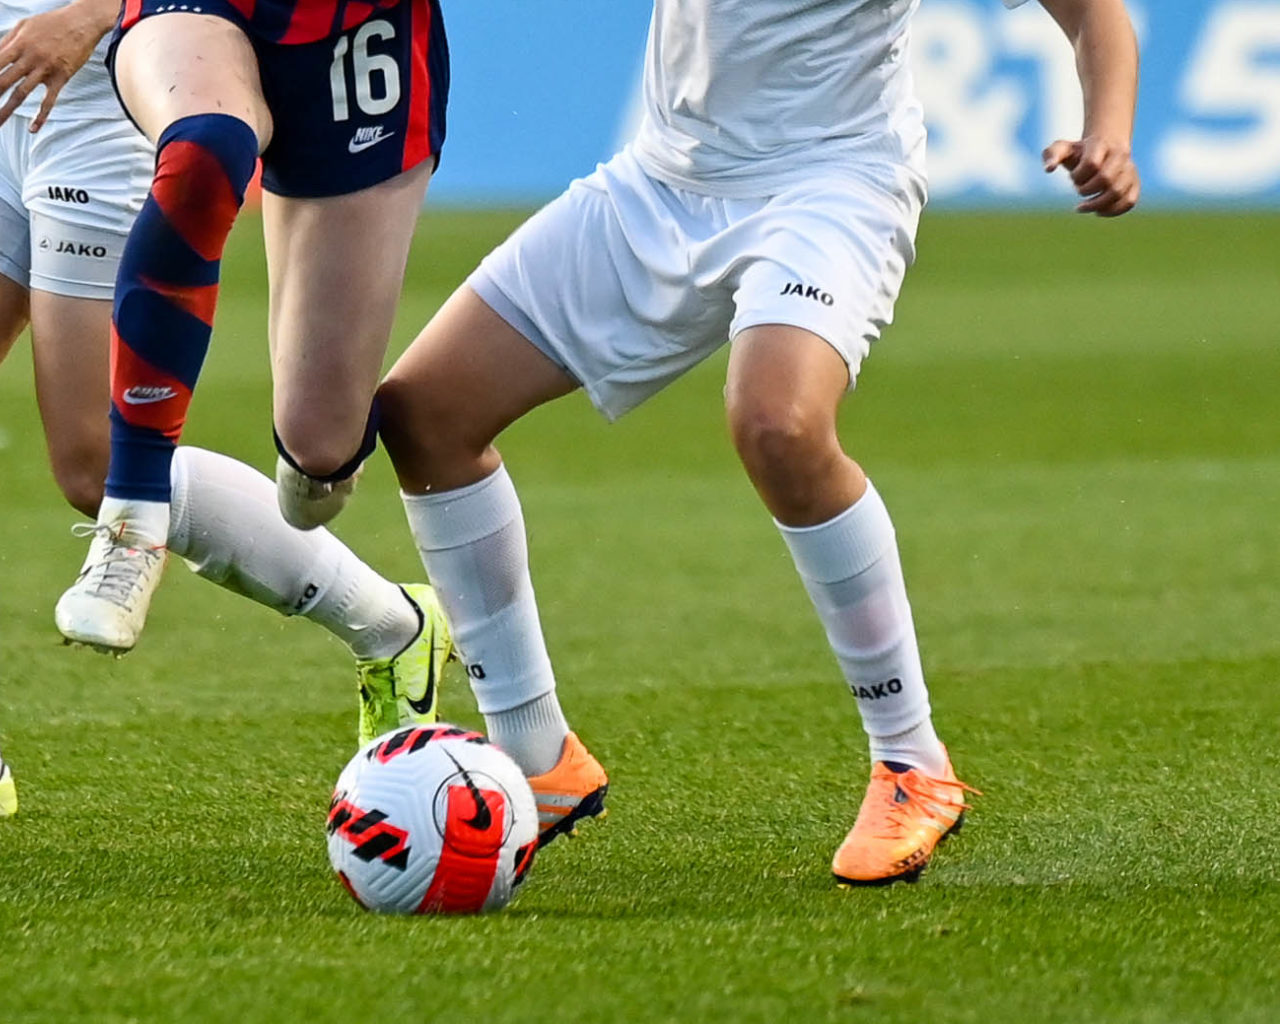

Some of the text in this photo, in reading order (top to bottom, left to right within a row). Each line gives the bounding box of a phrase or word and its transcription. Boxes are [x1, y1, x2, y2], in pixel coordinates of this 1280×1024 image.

[330, 19, 402, 122] 16
[354, 127, 386, 143] NIKE
[55, 241, 107, 258] JAKO
[780, 282, 834, 306] JAKO
[849, 678, 904, 701] JAKO
